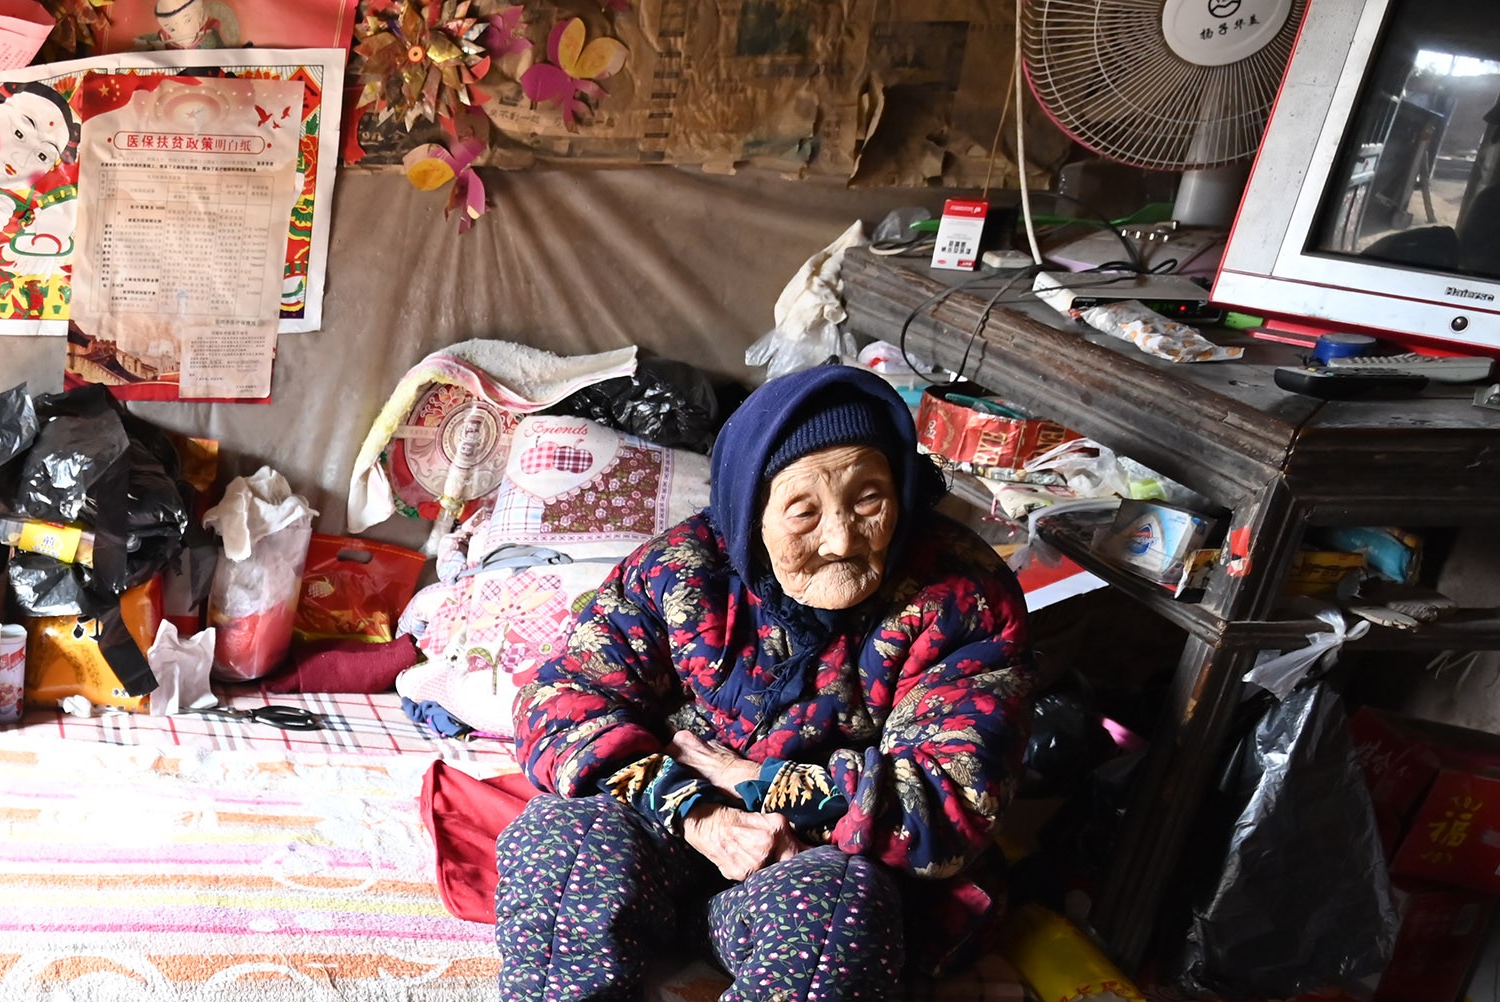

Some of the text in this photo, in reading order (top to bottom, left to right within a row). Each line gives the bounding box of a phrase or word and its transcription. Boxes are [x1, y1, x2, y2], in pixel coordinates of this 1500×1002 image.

[126, 134, 252, 152] 医保扶贫政策明白纸
[523, 419, 589, 438] Friends
